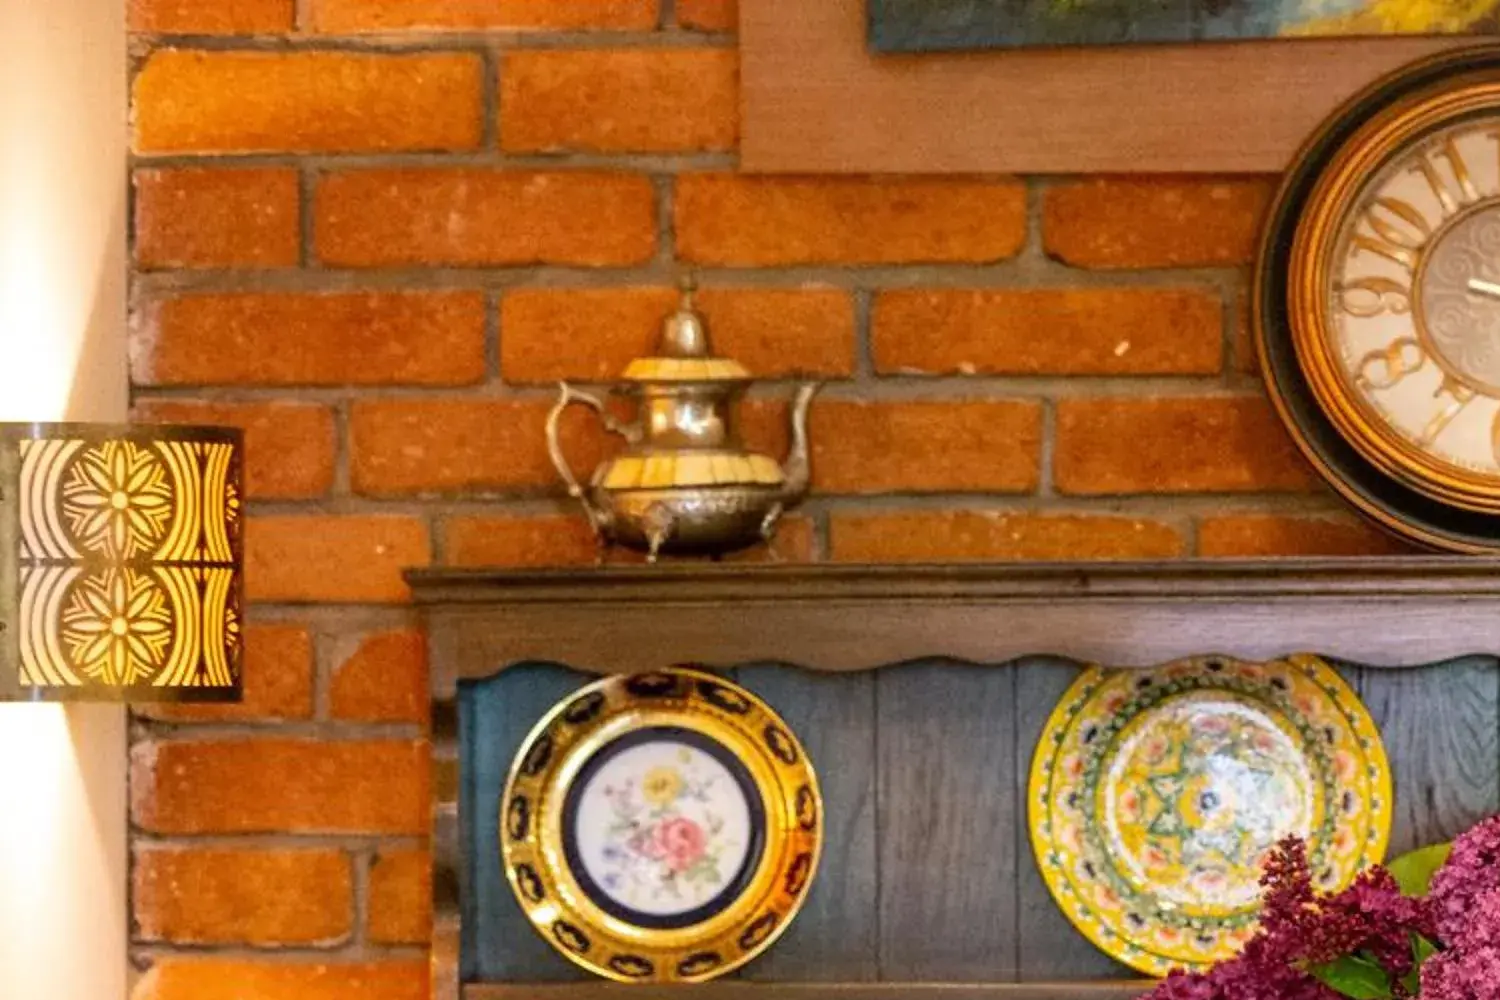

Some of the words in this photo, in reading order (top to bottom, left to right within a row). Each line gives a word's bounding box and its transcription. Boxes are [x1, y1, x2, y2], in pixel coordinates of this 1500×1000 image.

[1408, 135, 1481, 217] 11
[1349, 196, 1431, 277] 10
[1338, 275, 1412, 318] 9
[1353, 336, 1426, 392] 8
[1421, 376, 1478, 447] 7
